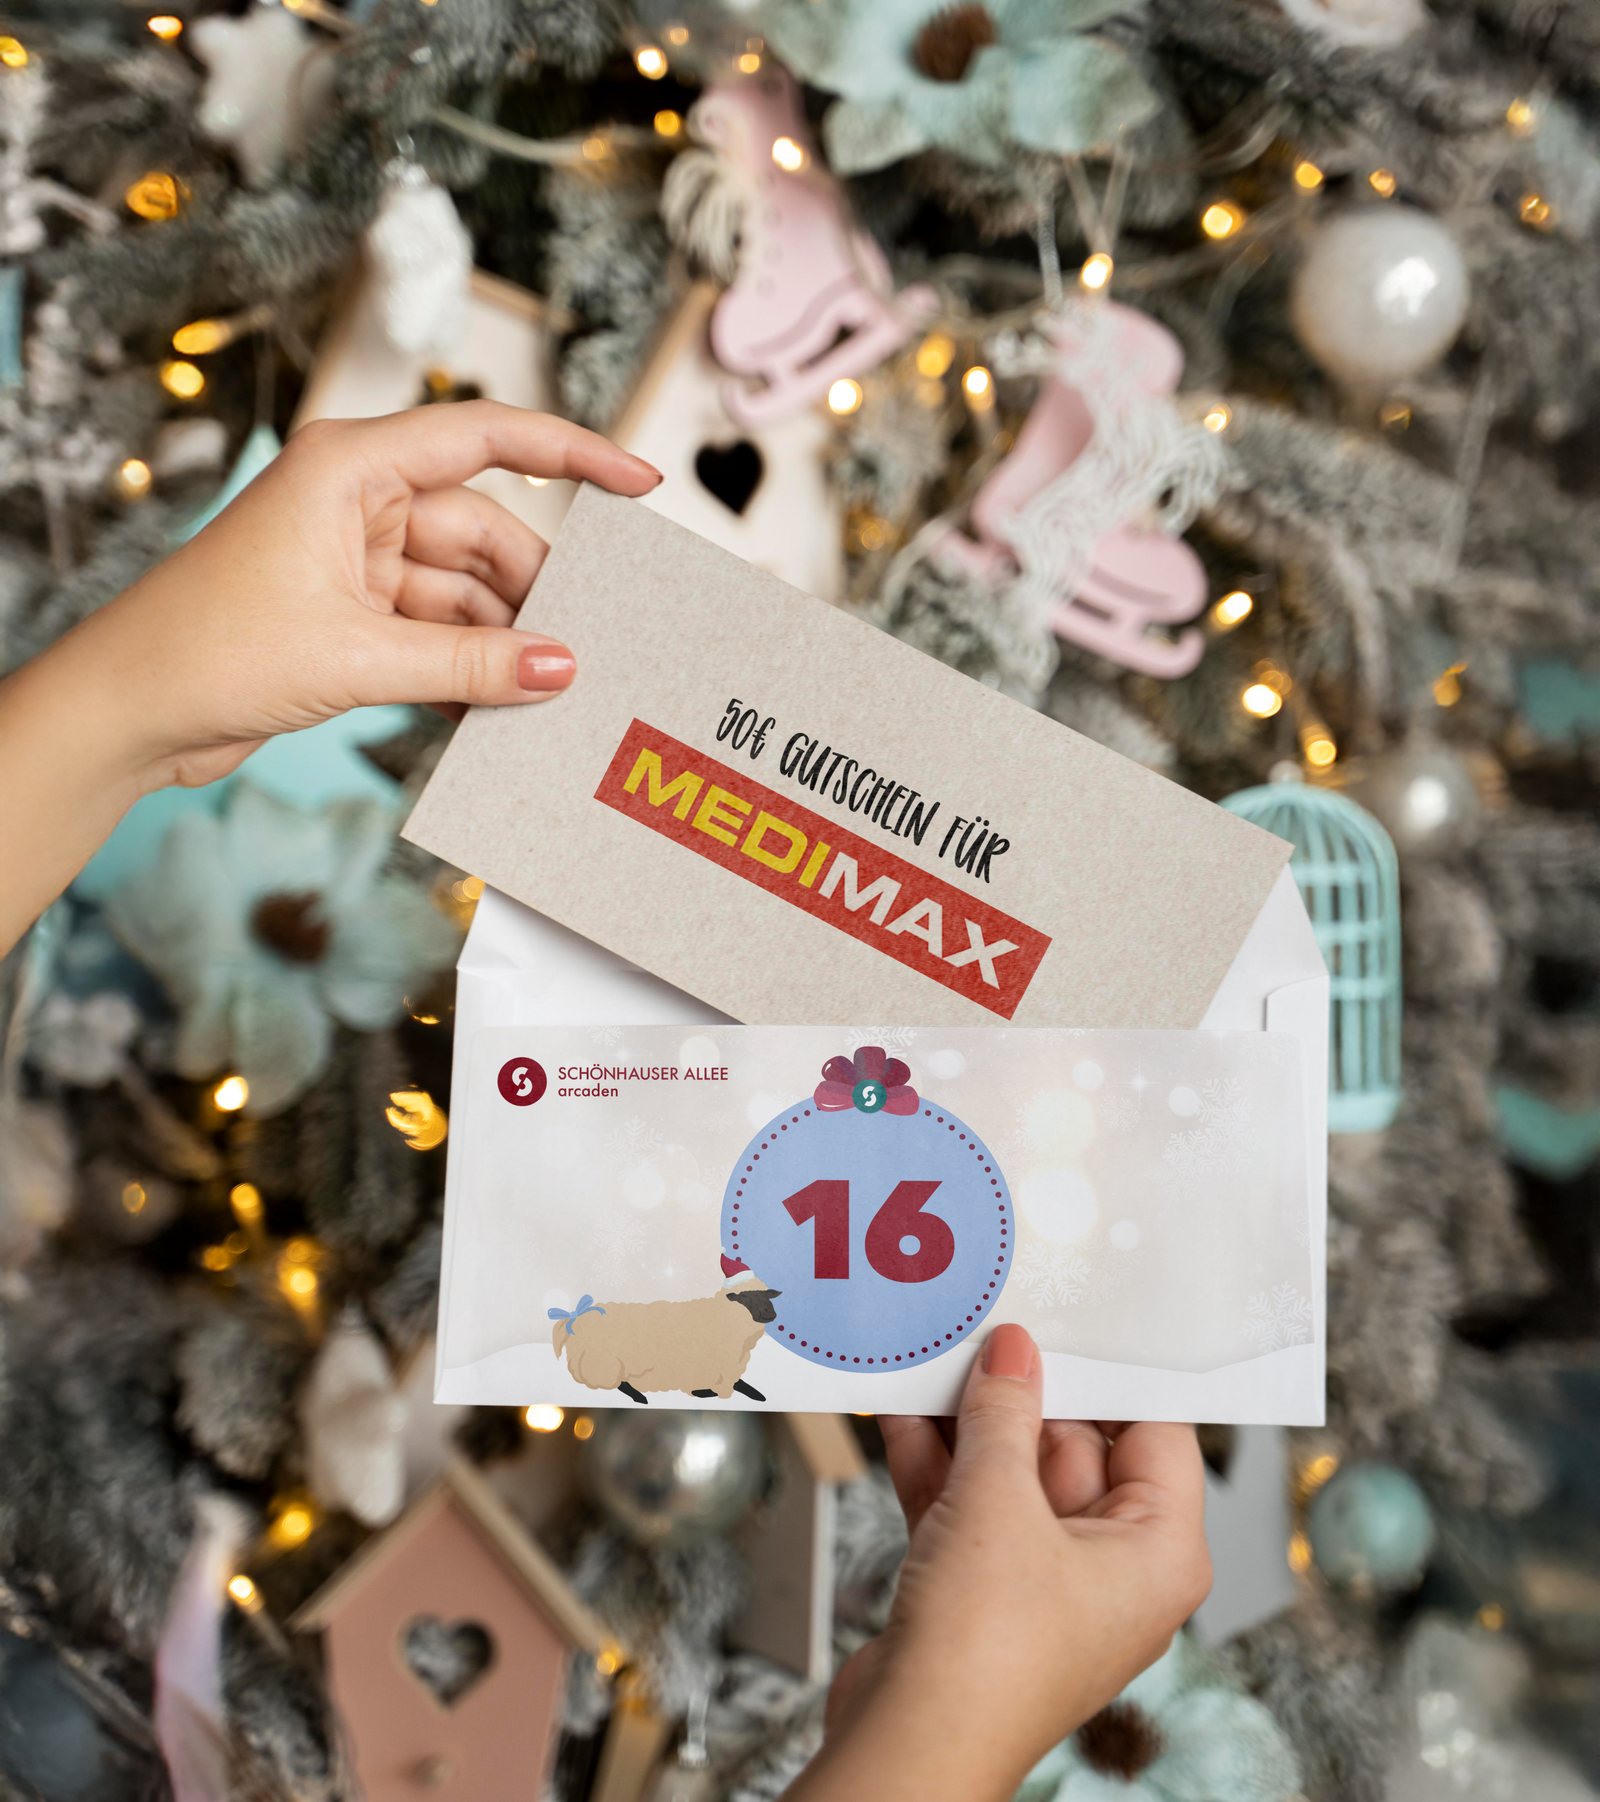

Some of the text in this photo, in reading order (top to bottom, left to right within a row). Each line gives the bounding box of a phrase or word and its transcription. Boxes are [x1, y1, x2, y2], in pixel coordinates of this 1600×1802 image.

[716, 698, 1010, 883] 50€ GUTSCHEIN FÜR
[623, 747, 1020, 990] MEDIMAX
[558, 1064, 728, 1081] SCHÖNHAUSER ALLEE
[558, 1083, 619, 1097] arcaden
[781, 1179, 955, 1284] 16
